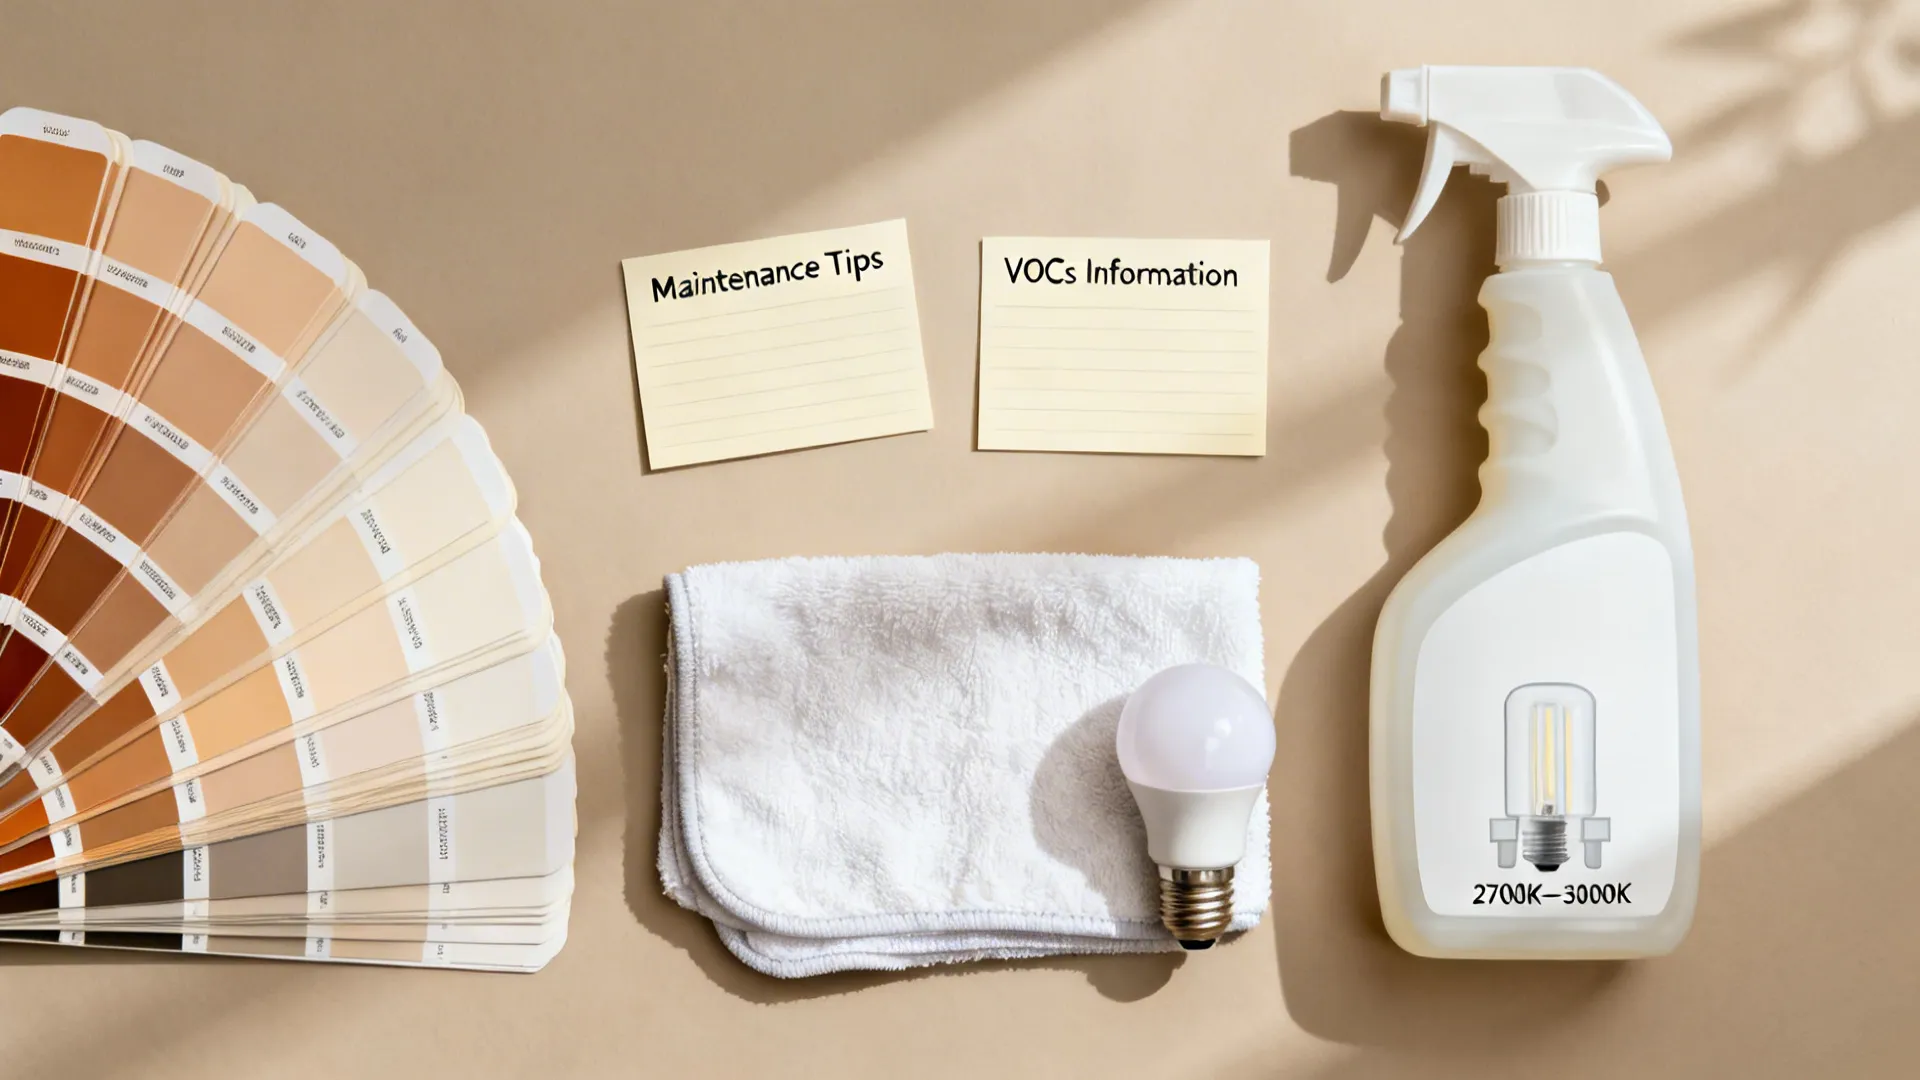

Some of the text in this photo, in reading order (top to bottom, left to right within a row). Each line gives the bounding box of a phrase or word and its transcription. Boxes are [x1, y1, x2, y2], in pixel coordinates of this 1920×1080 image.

[651, 247, 884, 303] Maintenance Tips
[1004, 257, 1239, 288] VOCs Information
